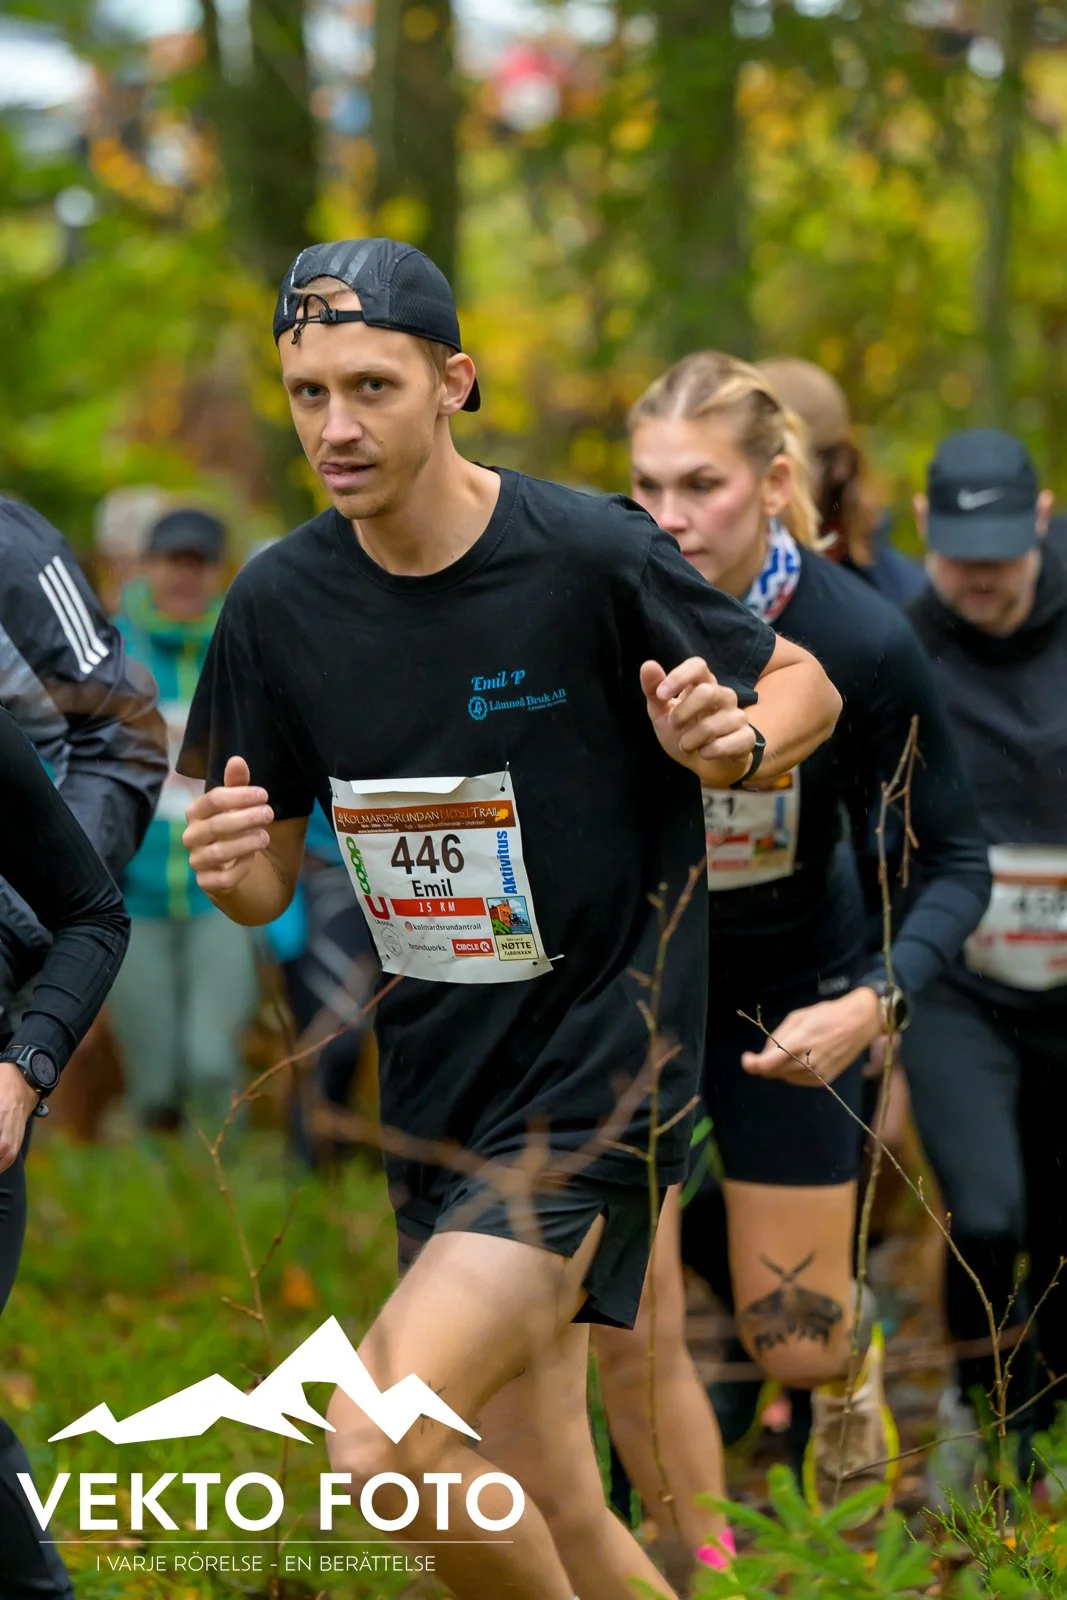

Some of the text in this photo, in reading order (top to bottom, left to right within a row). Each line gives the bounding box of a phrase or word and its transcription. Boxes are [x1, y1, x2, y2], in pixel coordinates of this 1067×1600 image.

[471, 669, 525, 691] Emil P
[526, 692, 551, 705] Bruk
[552, 688, 566, 700] AB
[391, 834, 465, 875] 446
[496, 830, 518, 895] Aktivitus
[411, 877, 454, 898] Emil
[419, 901, 456, 913] 15 KM
[455, 943, 480, 951] CIRCLE
[501, 941, 532, 950] NØTTE
